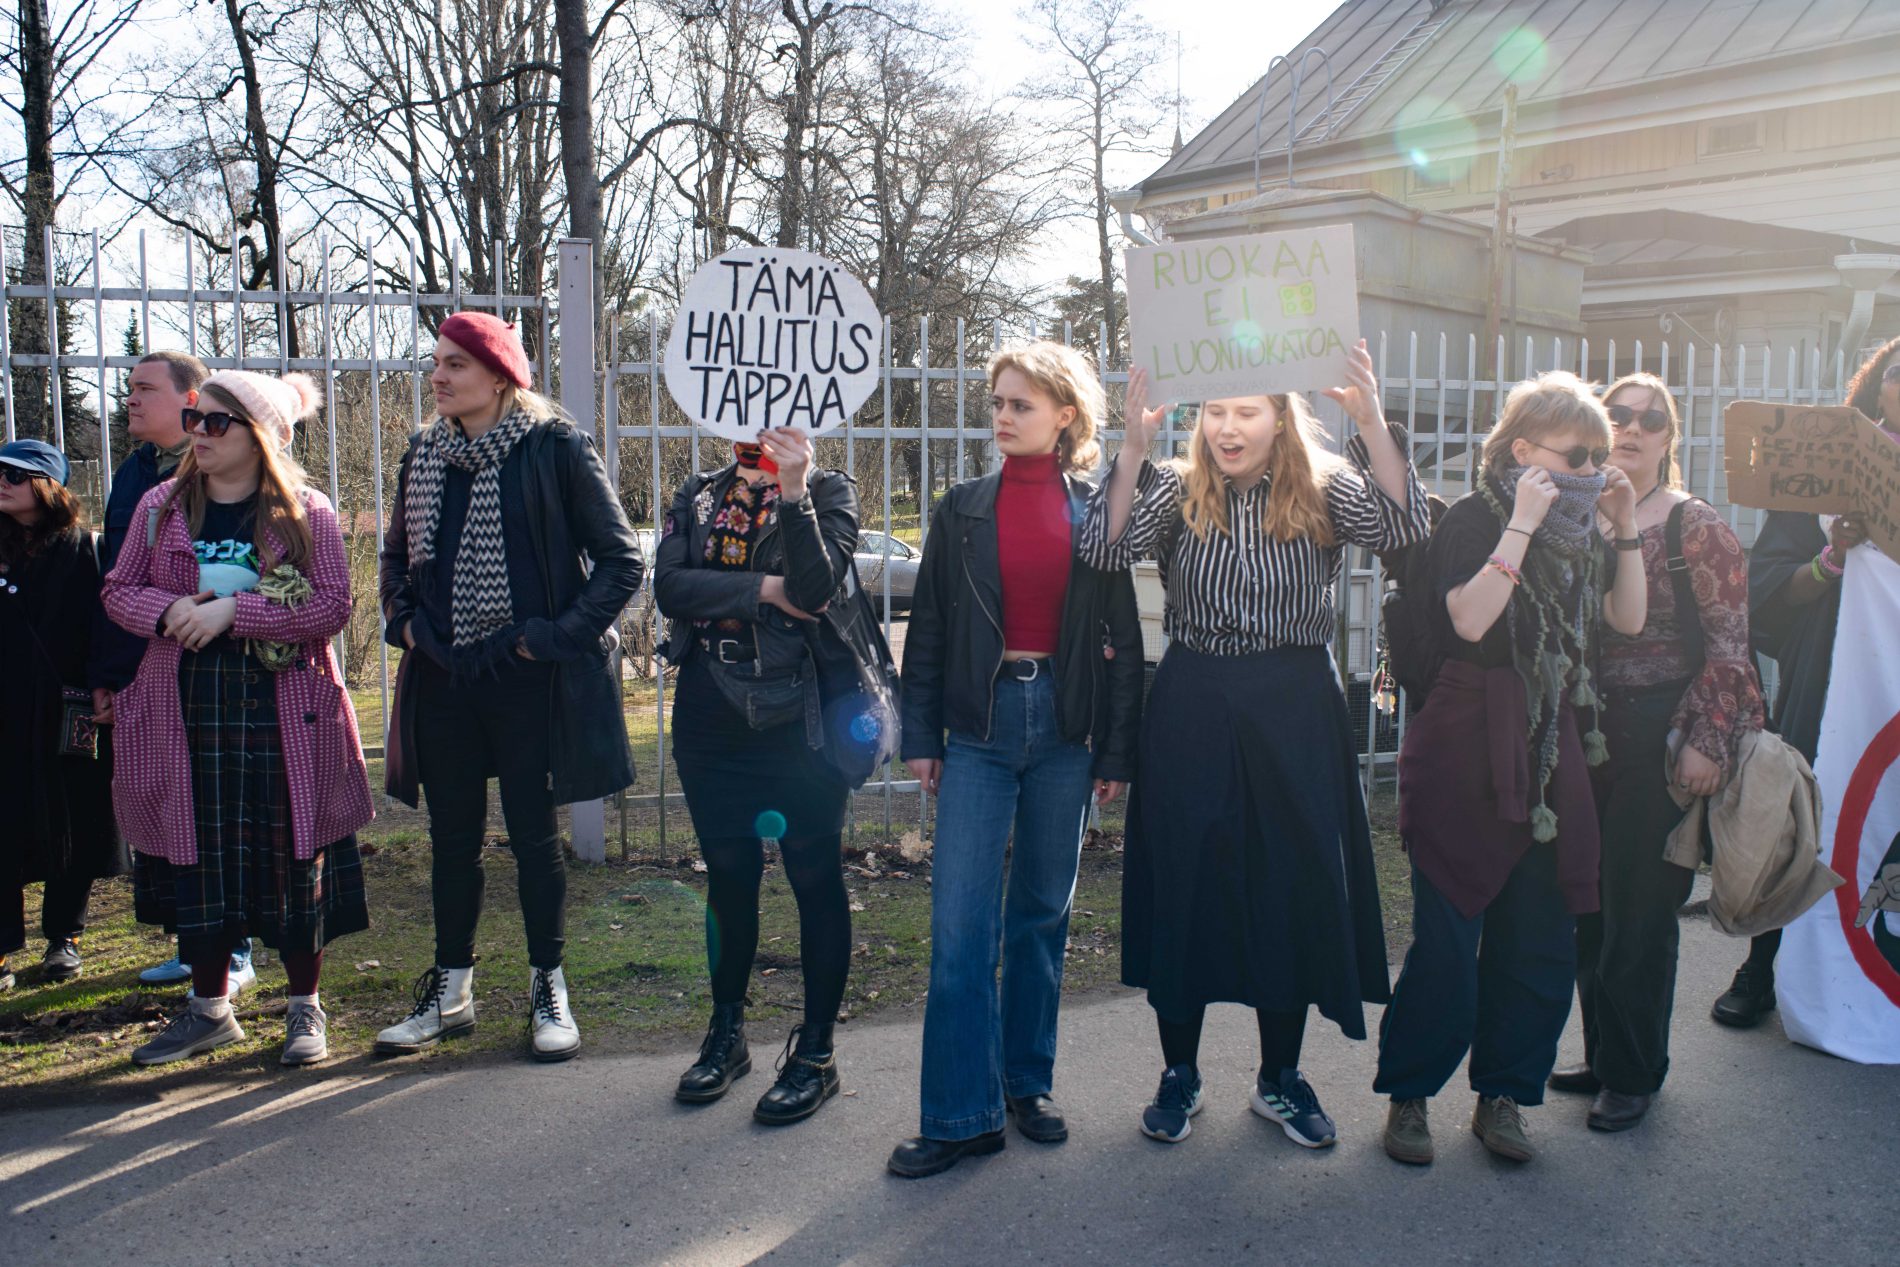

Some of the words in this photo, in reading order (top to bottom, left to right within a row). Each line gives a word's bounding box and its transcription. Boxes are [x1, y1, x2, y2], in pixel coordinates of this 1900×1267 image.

[720, 257, 845, 317] TÄMÄ
[1153, 239, 1331, 290] RUOKAA
[1203, 286, 1251, 327] EI
[686, 311, 873, 375] HALLITUS
[1152, 327, 1348, 381] LUONTOKATOA
[689, 366, 846, 429] TAPPAA
